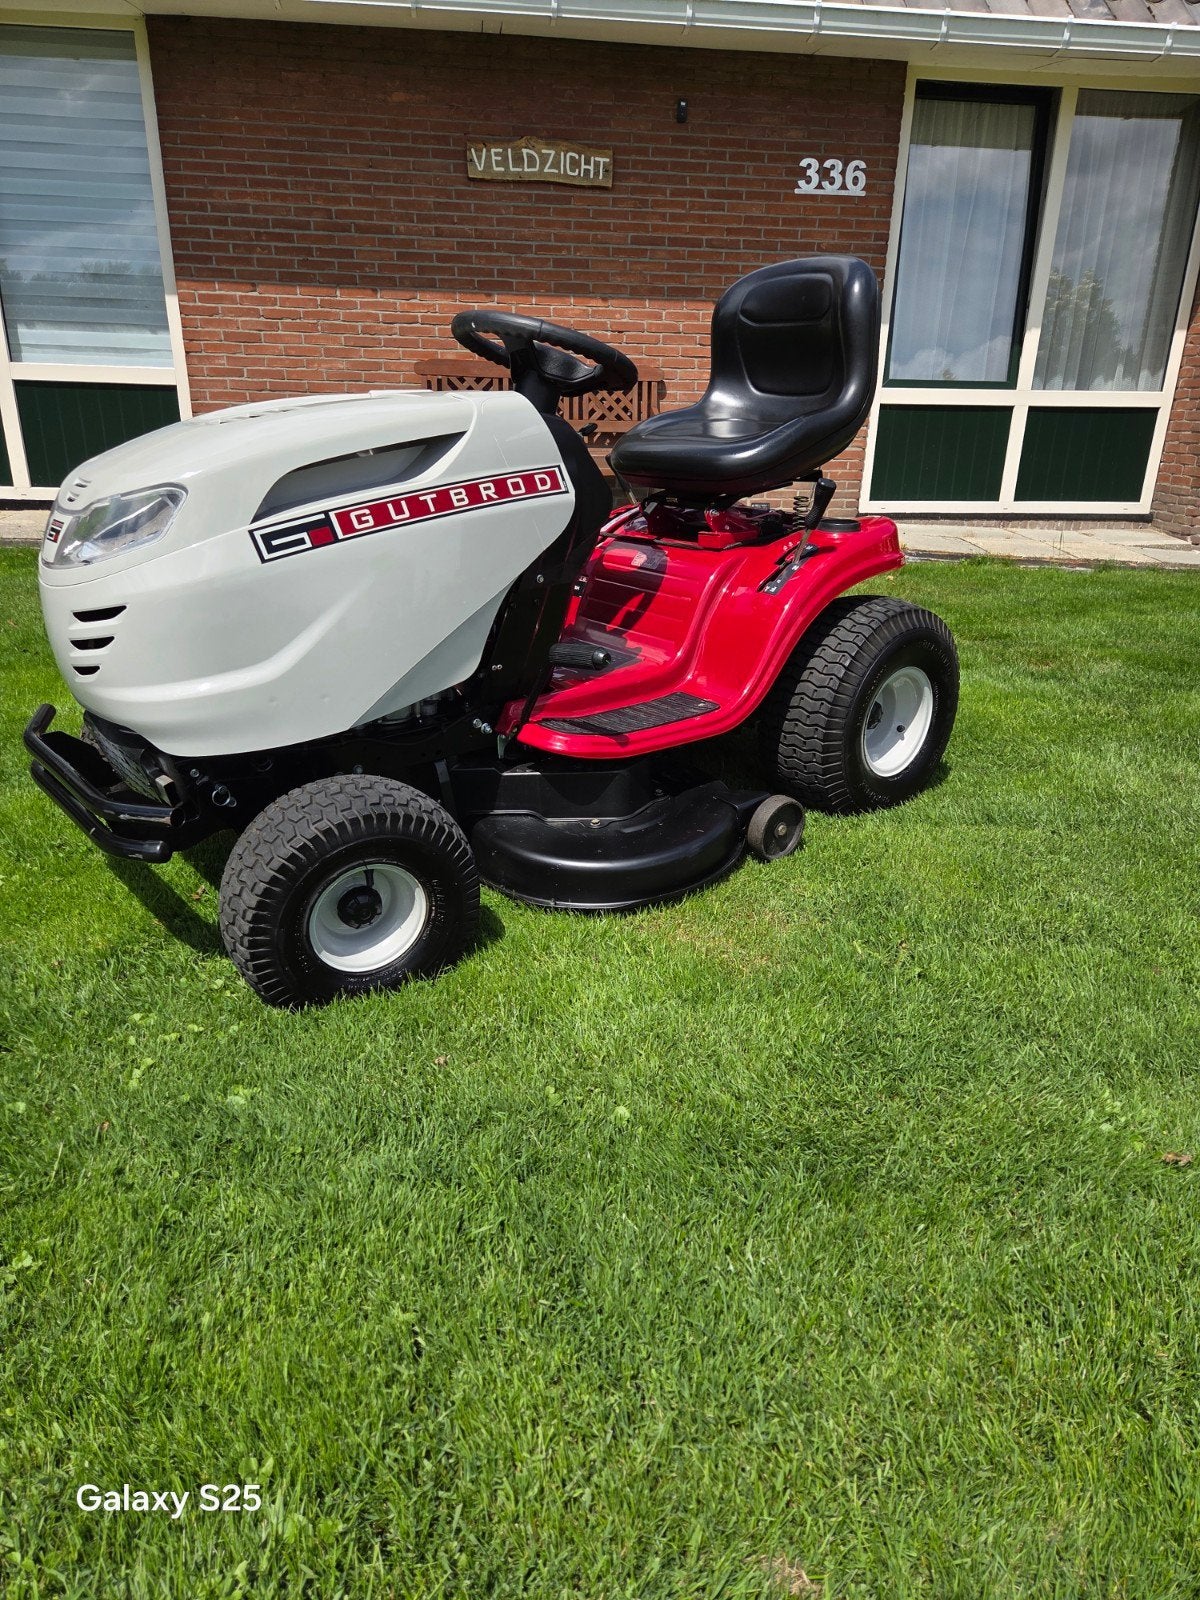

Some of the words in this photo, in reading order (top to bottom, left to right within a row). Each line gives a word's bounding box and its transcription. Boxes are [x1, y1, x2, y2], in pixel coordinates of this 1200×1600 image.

[470, 147, 610, 181] VELDZICHT
[796, 157, 867, 192] 336
[349, 473, 552, 531] GUTBROD
